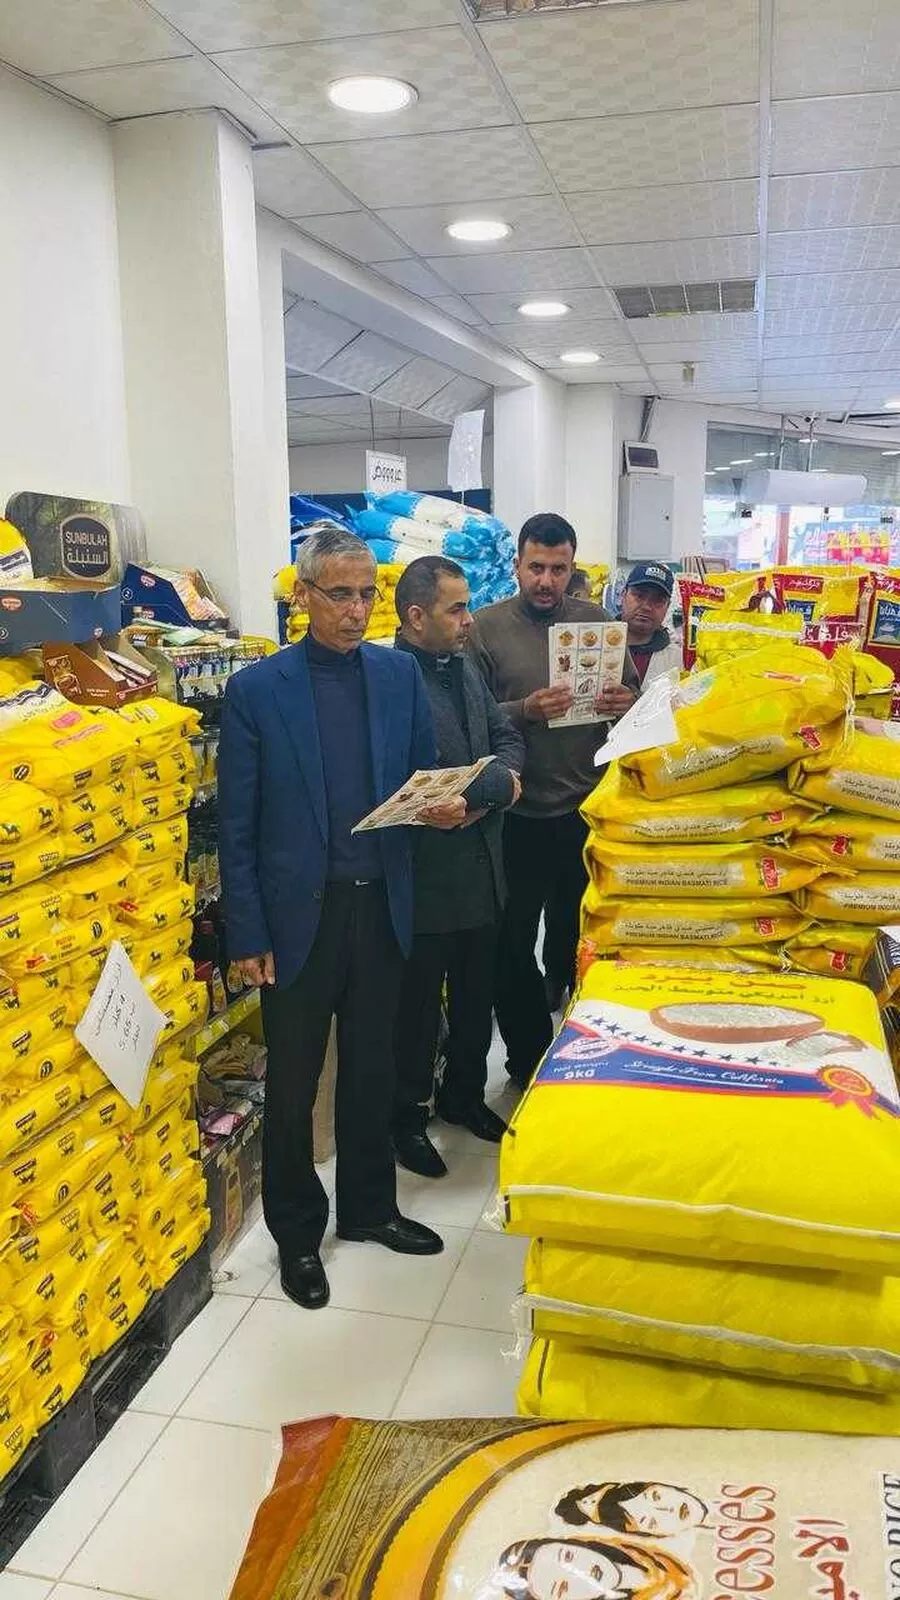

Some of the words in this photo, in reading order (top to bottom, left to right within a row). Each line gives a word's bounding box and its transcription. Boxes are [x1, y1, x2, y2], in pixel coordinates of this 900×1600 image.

[65, 531, 107, 546] SUNBULAH
[66, 548, 108, 568] السنبلة
[841, 787, 875, 799] PREMIUM
[682, 879, 711, 887] BASMATI
[843, 903, 876, 911] PREMIUM
[680, 933, 709, 941] BASMATI
[678, 1065, 716, 1079] From
[721, 1071, 785, 1085] California
[712, 1484, 777, 1600] esses
